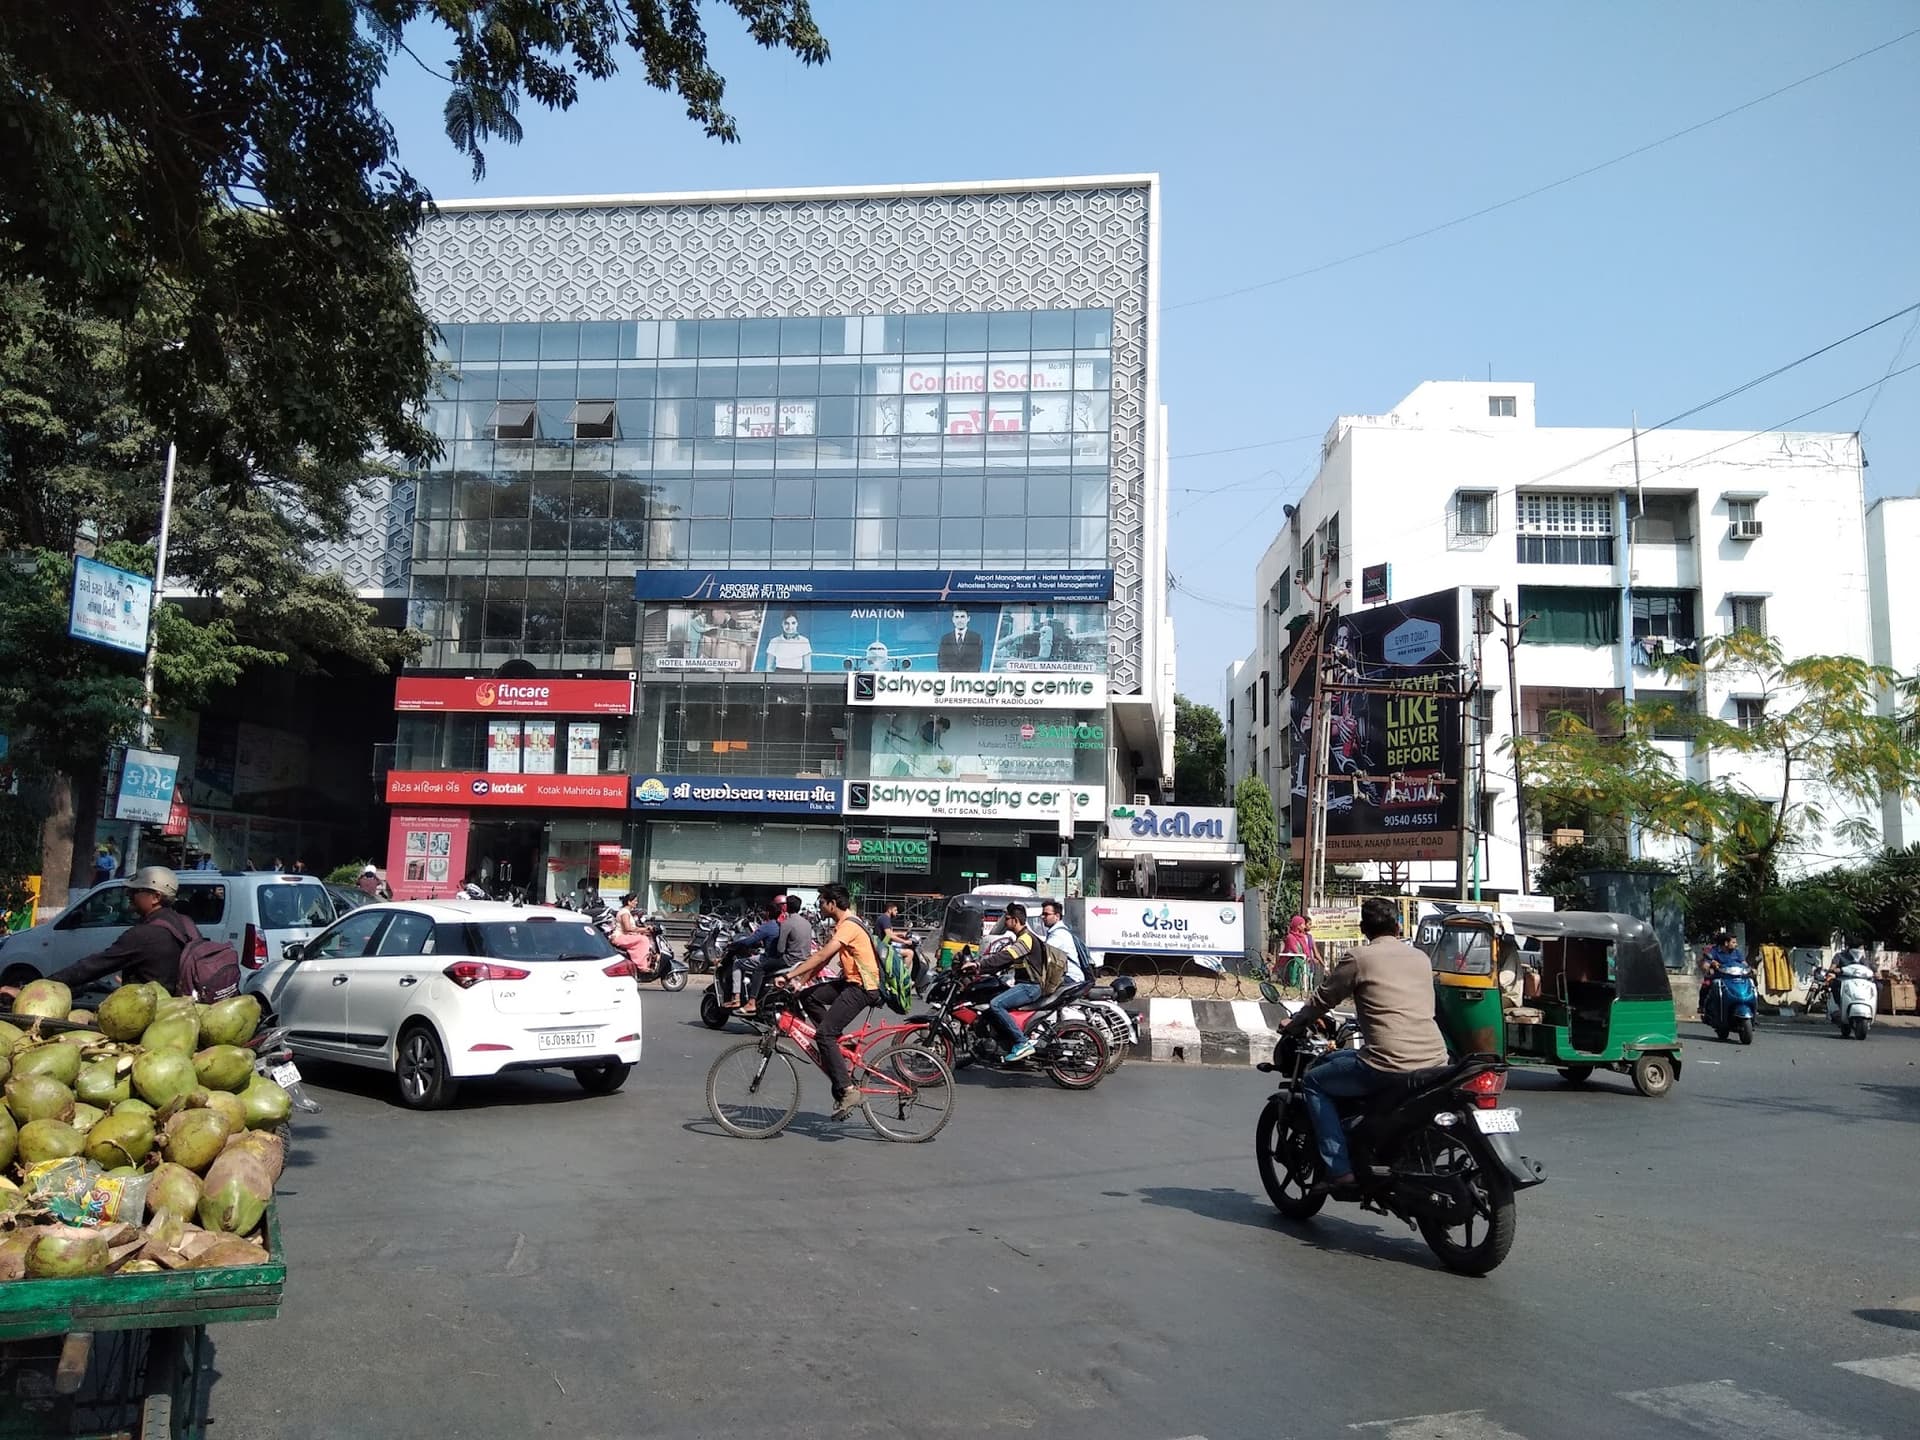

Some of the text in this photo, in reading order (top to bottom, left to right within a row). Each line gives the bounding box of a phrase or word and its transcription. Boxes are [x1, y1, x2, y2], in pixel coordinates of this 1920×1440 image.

[909, 369, 1063, 392] Coming Soon...
[726, 404, 815, 416] Coming oon...
[750, 422, 785, 437] GYM
[950, 409, 1020, 442] GYM
[974, 574, 994, 582] Airport
[995, 574, 1036, 582] Management
[1059, 574, 1101, 582] Management
[720, 584, 813, 592] AEROSTAR JET TRAINING
[987, 582, 1010, 590] Training
[1057, 582, 1099, 590] Management
[719, 591, 790, 599] ACADEMY PVT LTD
[850, 608, 905, 619] AVIATION
[658, 659, 739, 668] HOTEL MANAGEMENT
[1009, 661, 1094, 672] TRAVEL MANAGEMENT
[498, 684, 549, 698] fincare
[877, 675, 1094, 697] Sahyog imaging centre
[934, 697, 999, 705] SUPERSPECIALITY
[1387, 696, 1440, 728] LIKE
[1037, 724, 1104, 740] SAHYOG
[1387, 724, 1439, 748] NEVER
[1387, 745, 1441, 766] BEFORE
[391, 780, 412, 793] કોટક
[491, 782, 523, 795] kotak
[537, 785, 561, 796] Kotak
[563, 786, 601, 797] Mahindra
[603, 786, 623, 797] Bank
[672, 783, 691, 799] શ્રી
[766, 788, 809, 801] મસાલા
[810, 785, 836, 802] મીલ
[871, 784, 1090, 808] Sahyog imaging cee
[931, 807, 946, 815] MRI,
[959, 808, 980, 816] SCAN,
[982, 808, 998, 816] USG
[168, 815, 187, 825] ATM
[1130, 808, 1224, 838] એલીના
[1384, 812, 1438, 827] 90540 45551
[862, 840, 928, 855] SAHYOG
[1364, 838, 1391, 848] ANAND
[1421, 836, 1444, 846] ROAD
[903, 856, 928, 864] DENTAL
[545, 1033, 595, 1047] GJ05RB2117
